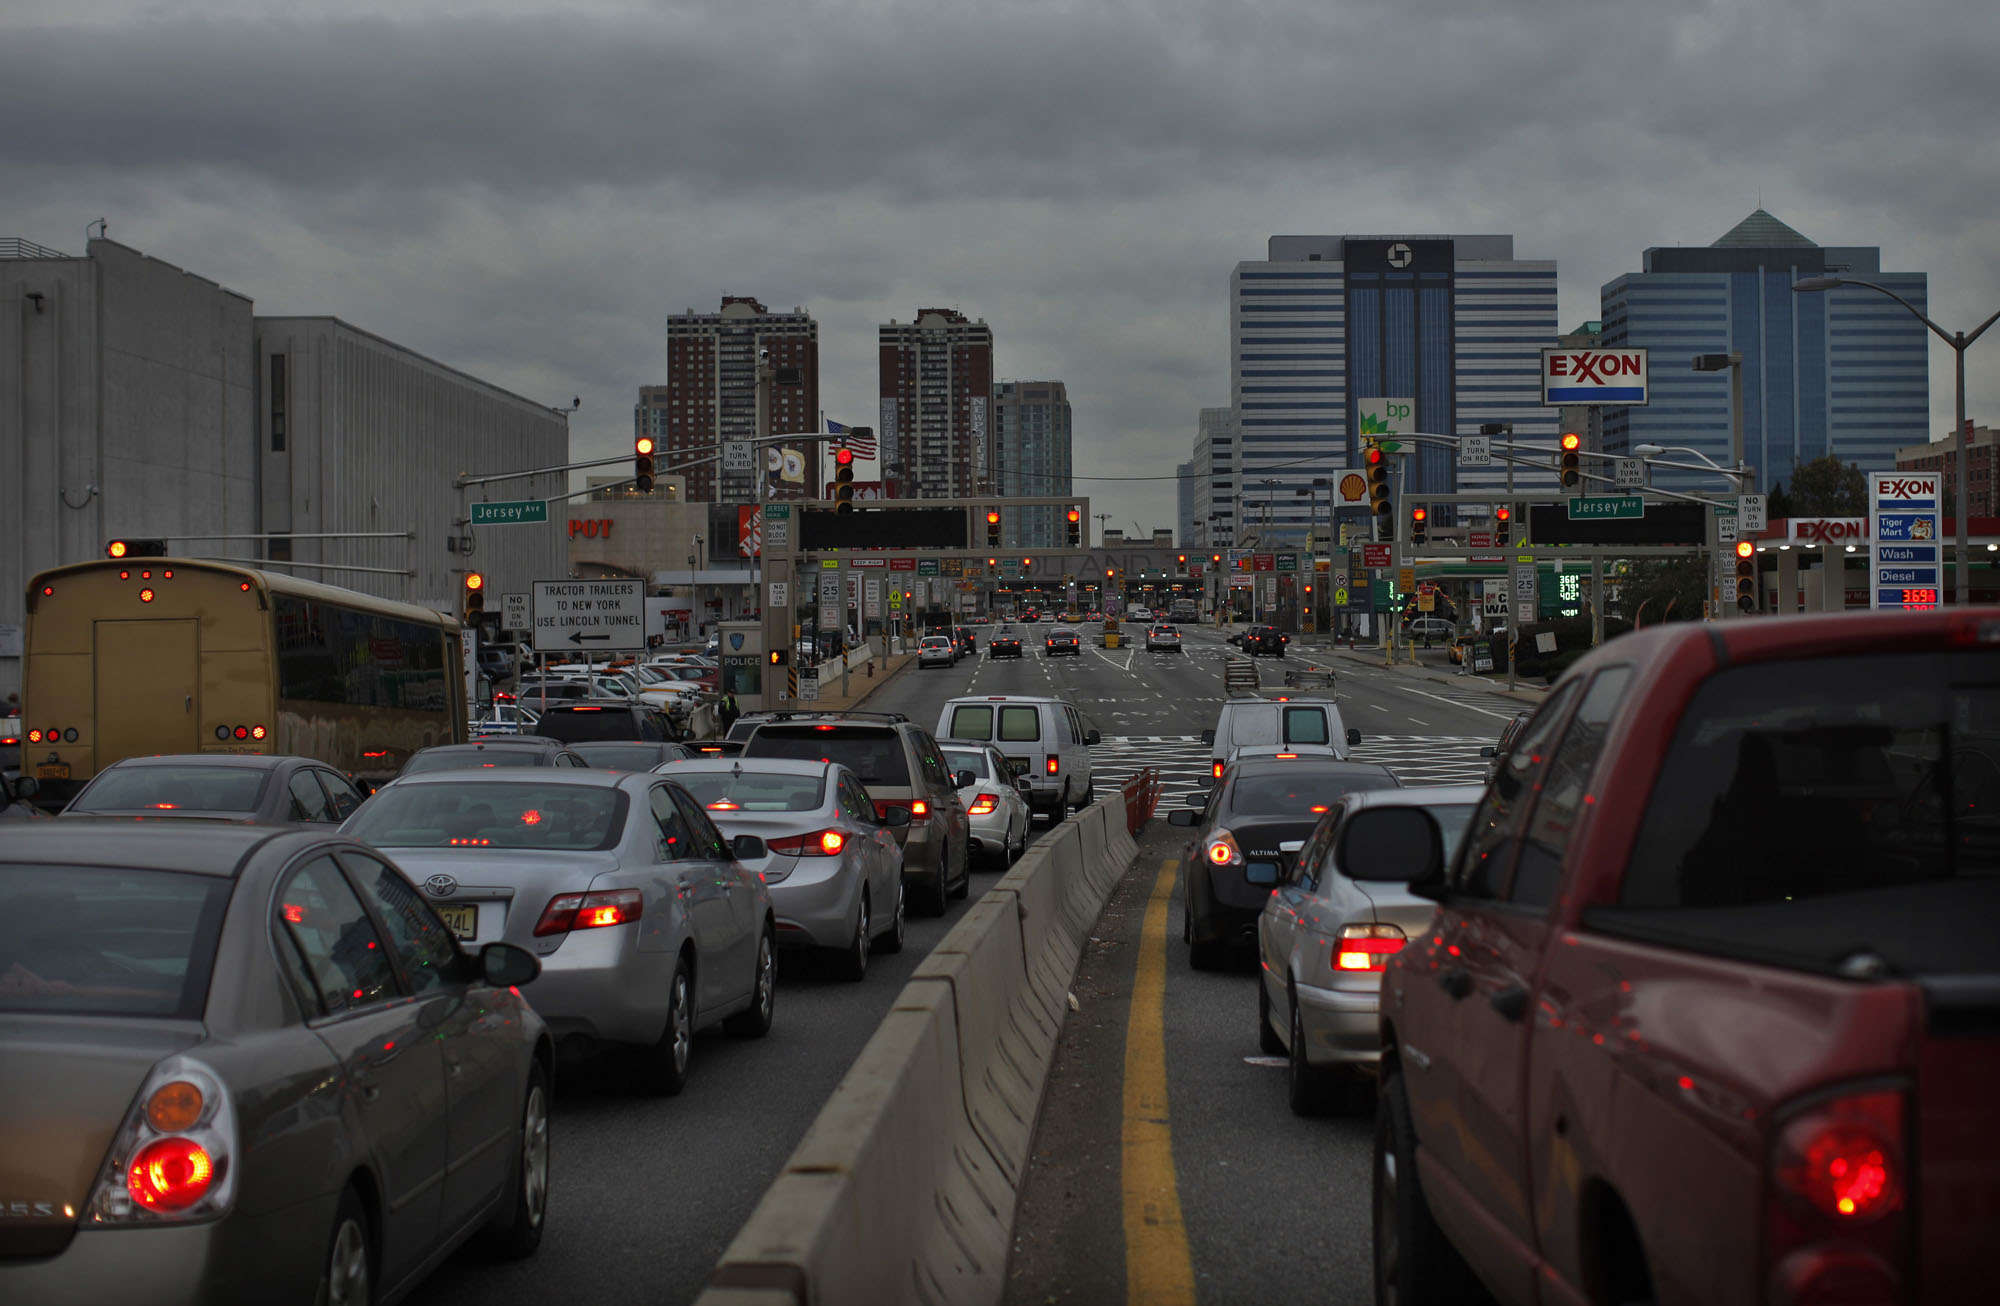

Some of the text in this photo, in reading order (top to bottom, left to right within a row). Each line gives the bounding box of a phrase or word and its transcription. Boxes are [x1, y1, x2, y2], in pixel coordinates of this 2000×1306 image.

[1550, 352, 1640, 385] EXXON
[1386, 400, 1410, 421] bp
[1623, 461, 1636, 469] NO
[1879, 479, 1934, 499] EXXON
[478, 504, 540, 519] Jersey Ave
[1576, 500, 1637, 515] Jersey Ave
[1880, 517, 1903, 528] Tiger
[1797, 520, 1859, 544] EXXON
[1880, 528, 1903, 537] Mart
[1881, 549, 1914, 559] Wash
[1880, 570, 1915, 581] Diesel
[1518, 580, 1533, 589] 25
[544, 585, 633, 596] TRACTOR TRAILERS
[823, 586, 838, 595] 25
[510, 596, 523, 604] NO
[557, 600, 621, 610] TO NEW YORK
[537, 615, 641, 627] USE LINCOLN TUNNEL
[724, 657, 761, 666] POLICE
